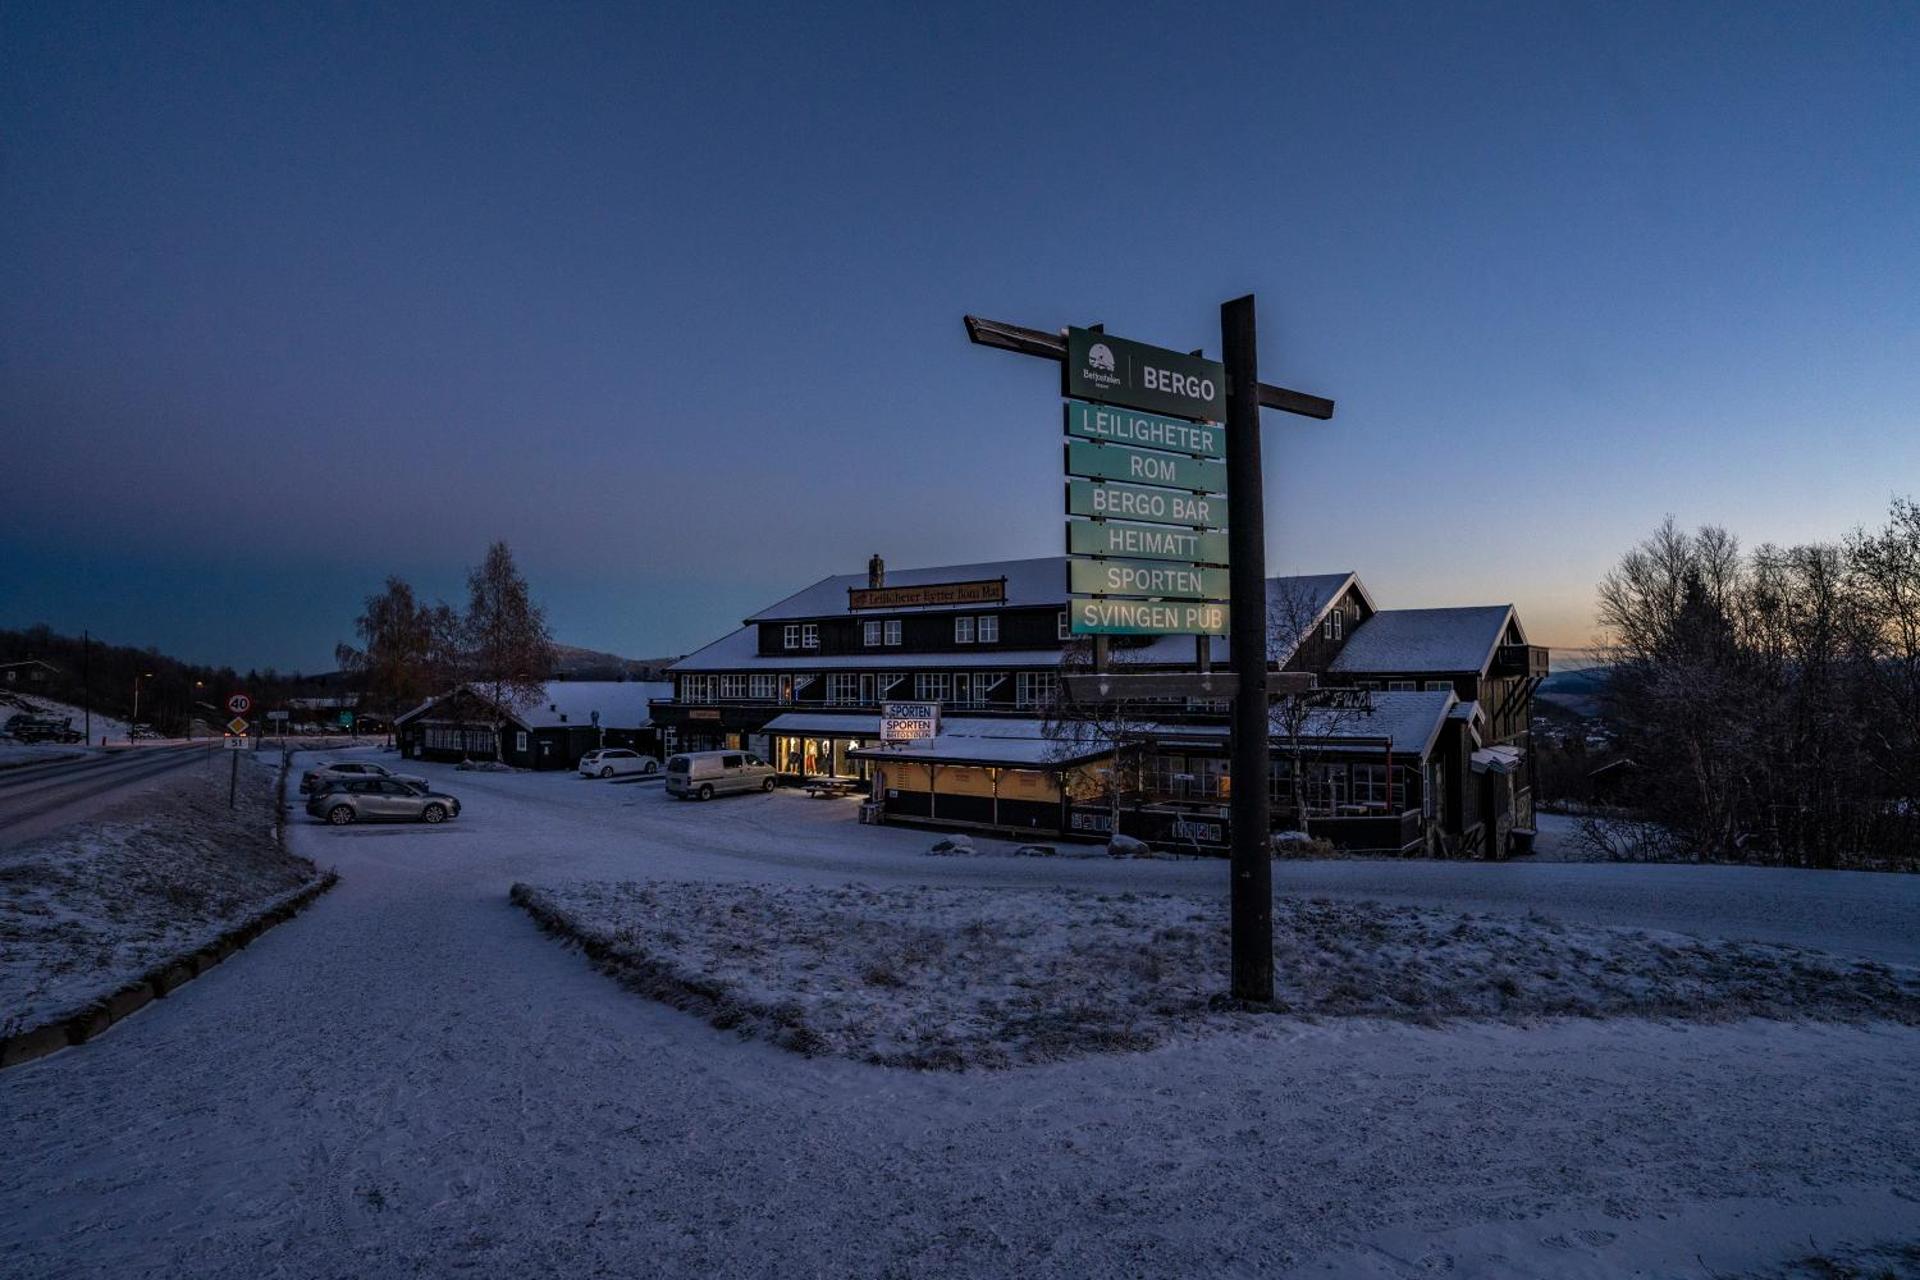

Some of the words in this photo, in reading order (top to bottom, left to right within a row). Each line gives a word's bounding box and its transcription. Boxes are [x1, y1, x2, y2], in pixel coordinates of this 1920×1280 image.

[1143, 365, 1215, 401] BERGO
[1082, 408, 1214, 452] LEILIGHETER
[1130, 455, 1176, 481] ROM
[1093, 488, 1165, 517] BERGO
[1172, 498, 1209, 522] BAR
[1109, 529, 1198, 556] HEIMATT
[1107, 568, 1202, 593] SPORTEN
[1084, 604, 1179, 629] SVINGEN
[1185, 608, 1222, 630] PUB
[230, 698, 248, 709] 40
[890, 705, 931, 717] SPORTEN
[886, 720, 930, 729] SPORTEN
